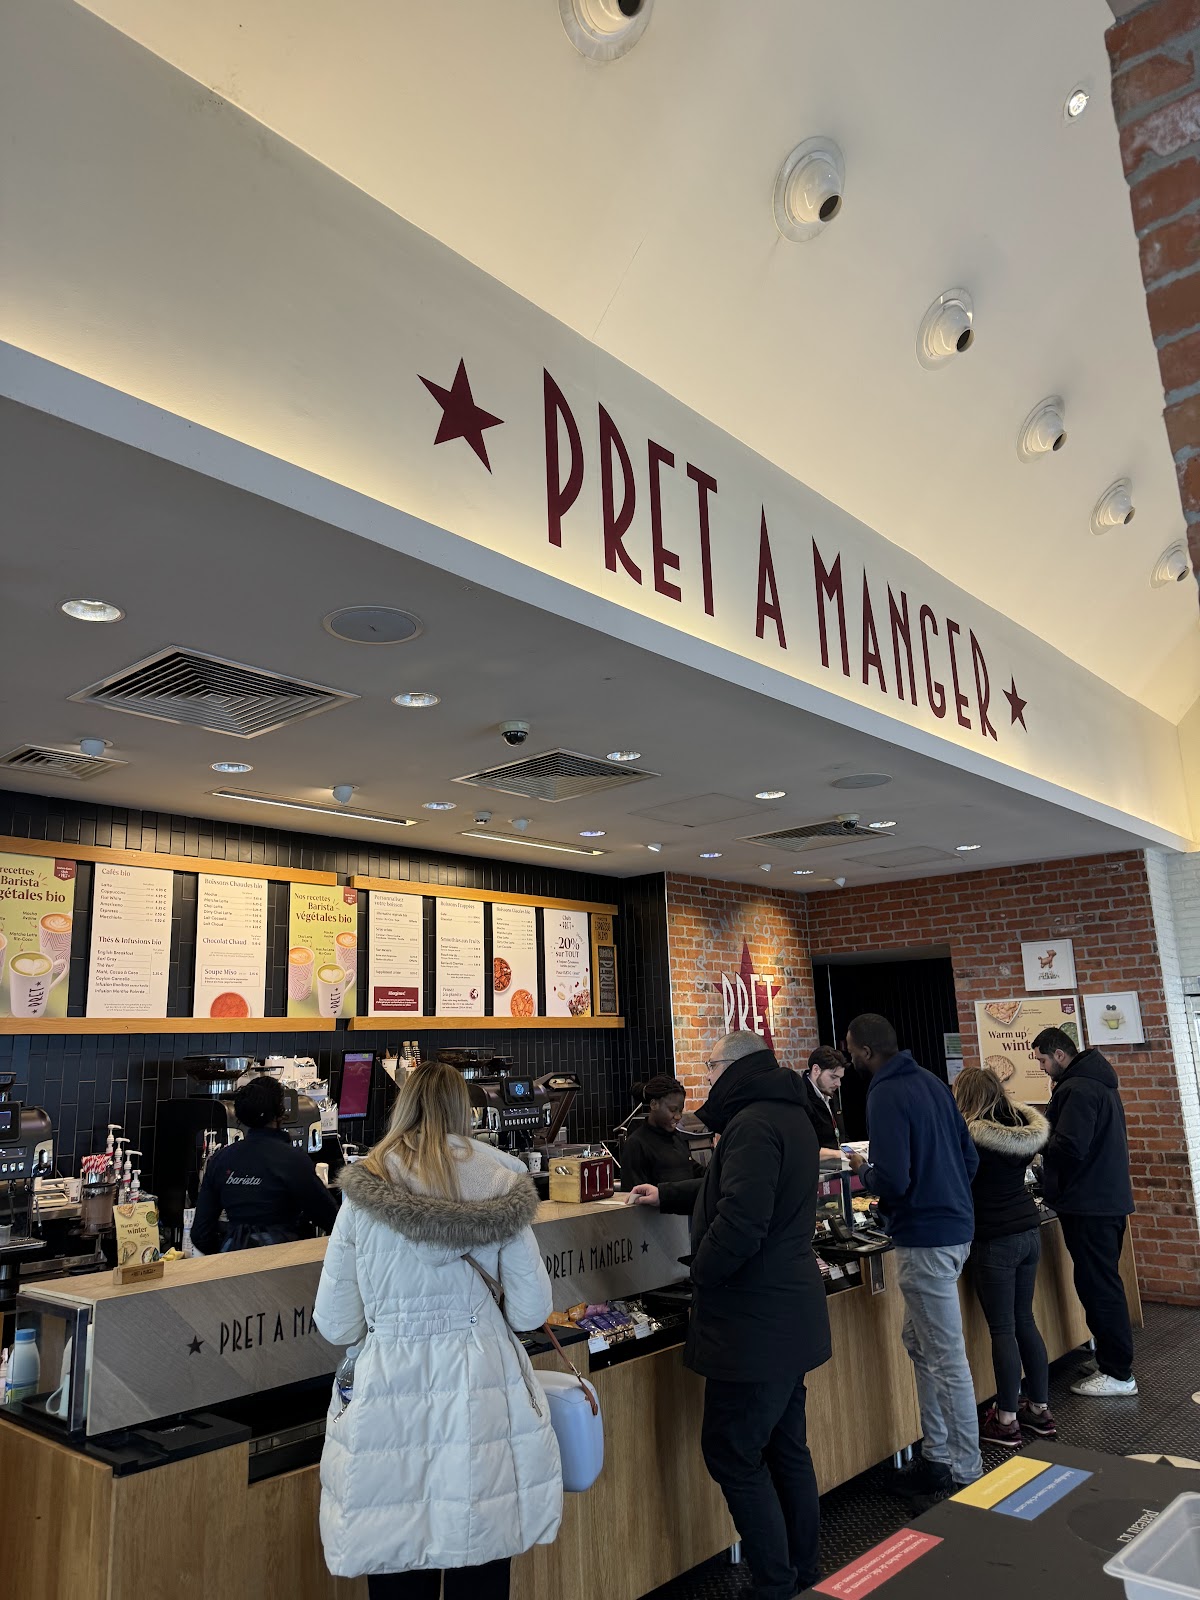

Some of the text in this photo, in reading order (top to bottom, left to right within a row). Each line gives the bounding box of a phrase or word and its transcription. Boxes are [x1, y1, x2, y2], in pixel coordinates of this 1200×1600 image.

[543, 366, 998, 742] PRET A MANGER
[0, 867, 35, 876] recettes
[101, 868, 119, 876] Cafés
[1, 876, 40, 888] Barista
[229, 880, 253, 888] Chaudes
[0, 887, 66, 903] gétales bio
[294, 892, 306, 900] Nos
[308, 902, 334, 911] Barista
[296, 910, 352, 923] végétales bio
[121, 937, 151, 945] Infusions
[202, 937, 228, 945] Chocolat
[228, 938, 247, 946] Chaud
[558, 936, 580, 951] 20%
[565, 950, 580, 958] TOUT
[204, 968, 223, 976] Soupe
[28, 987, 45, 1007] PRET
[330, 992, 341, 1009] PRET
[720, 969, 776, 1037] PRET
[988, 1030, 1027, 1040] Warm up
[1001, 1039, 1032, 1052] wint
[225, 1170, 262, 1186] barista
[127, 1226, 148, 1235] winter
[545, 1238, 634, 1279] PRET A MANGER
[220, 1312, 266, 1355] PRET
[273, 1311, 284, 1342] A
